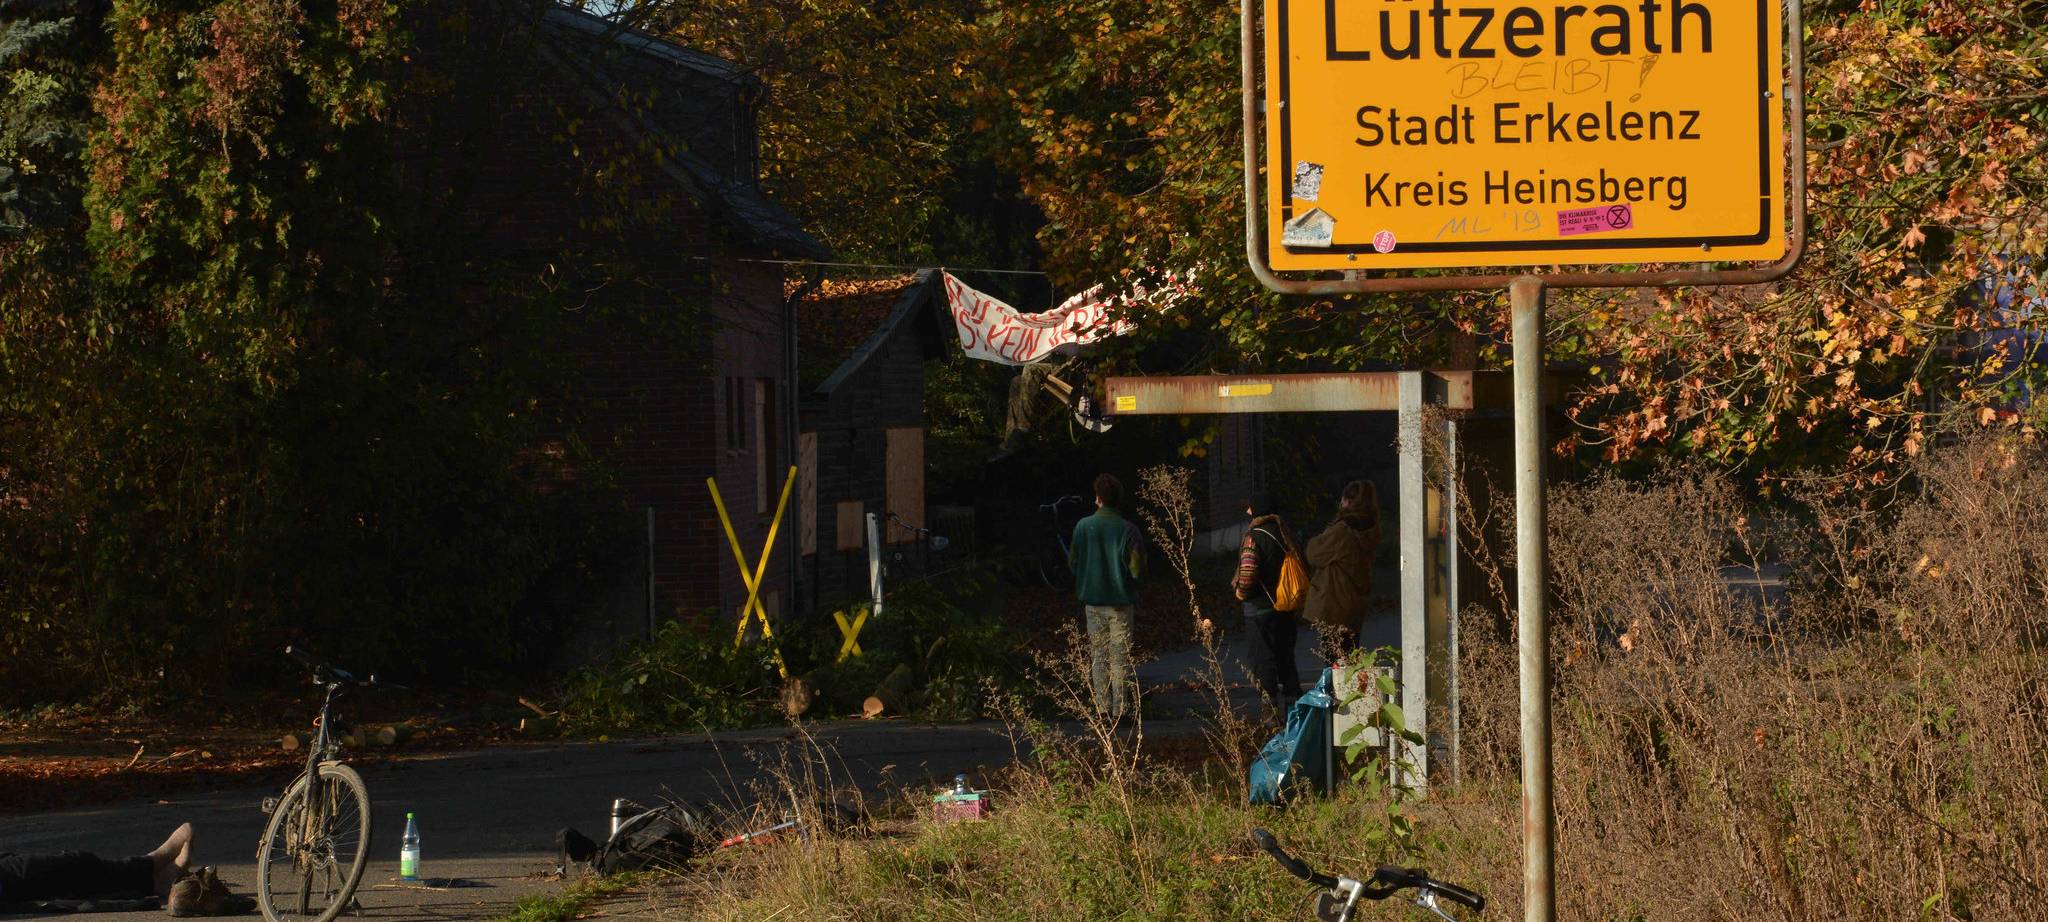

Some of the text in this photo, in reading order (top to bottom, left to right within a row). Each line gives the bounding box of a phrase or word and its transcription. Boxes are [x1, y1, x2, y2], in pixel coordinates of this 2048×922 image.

[1325, 0, 1713, 60] Lützerath
[1446, 54, 1659, 102] BLEIBT!
[1355, 101, 1701, 146] Stadt Erkelenz
[1365, 172, 1468, 207] Kreis
[1484, 169, 1687, 211] Heinsberg
